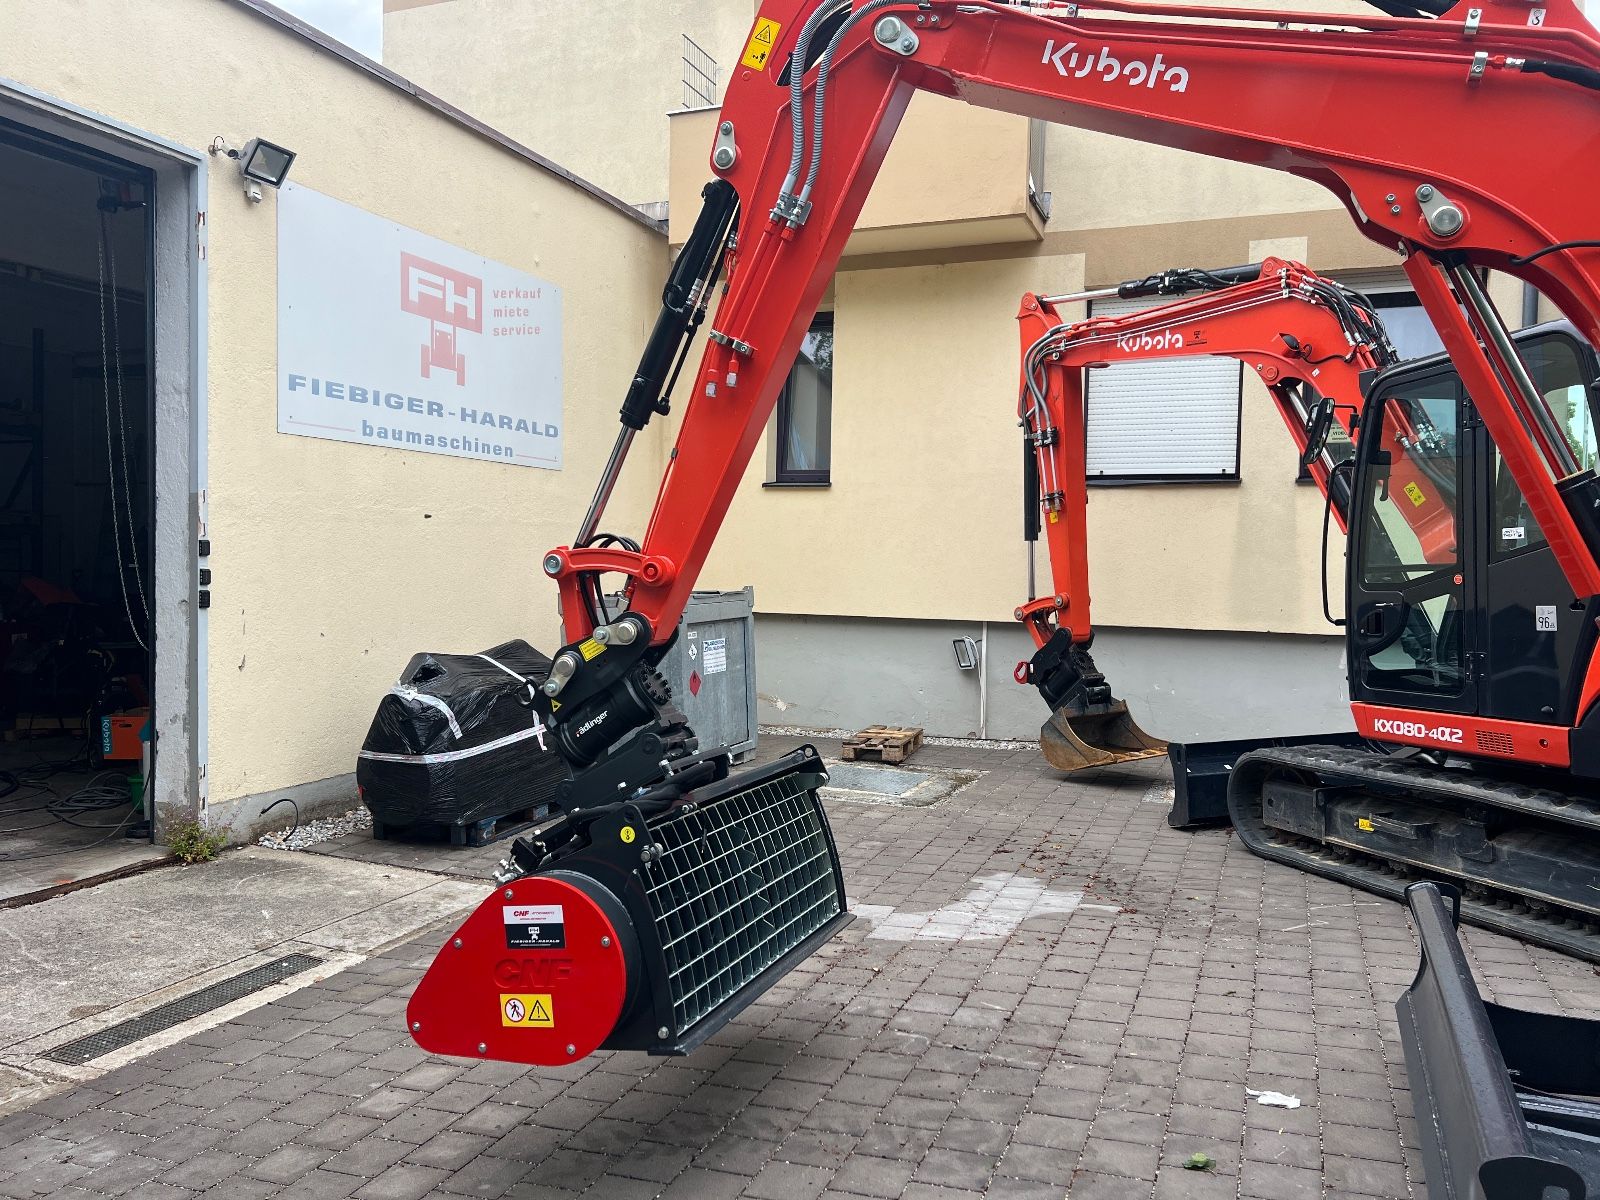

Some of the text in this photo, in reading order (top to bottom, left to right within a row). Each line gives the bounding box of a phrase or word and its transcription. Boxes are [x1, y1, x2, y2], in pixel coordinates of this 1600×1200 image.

[1041, 39, 1189, 93] Kubota
[409, 266, 475, 320] FH
[493, 287, 542, 299] verkauf
[493, 305, 529, 318] miete
[493, 323, 541, 336] service
[1117, 330, 1183, 352] Kubota
[288, 374, 559, 438] FIEBIGER-HARALD
[362, 420, 513, 457] baumaschinen
[1538, 616, 1550, 629] 96
[102, 719, 111, 752] Kubota
[493, 958, 575, 989] CNF
